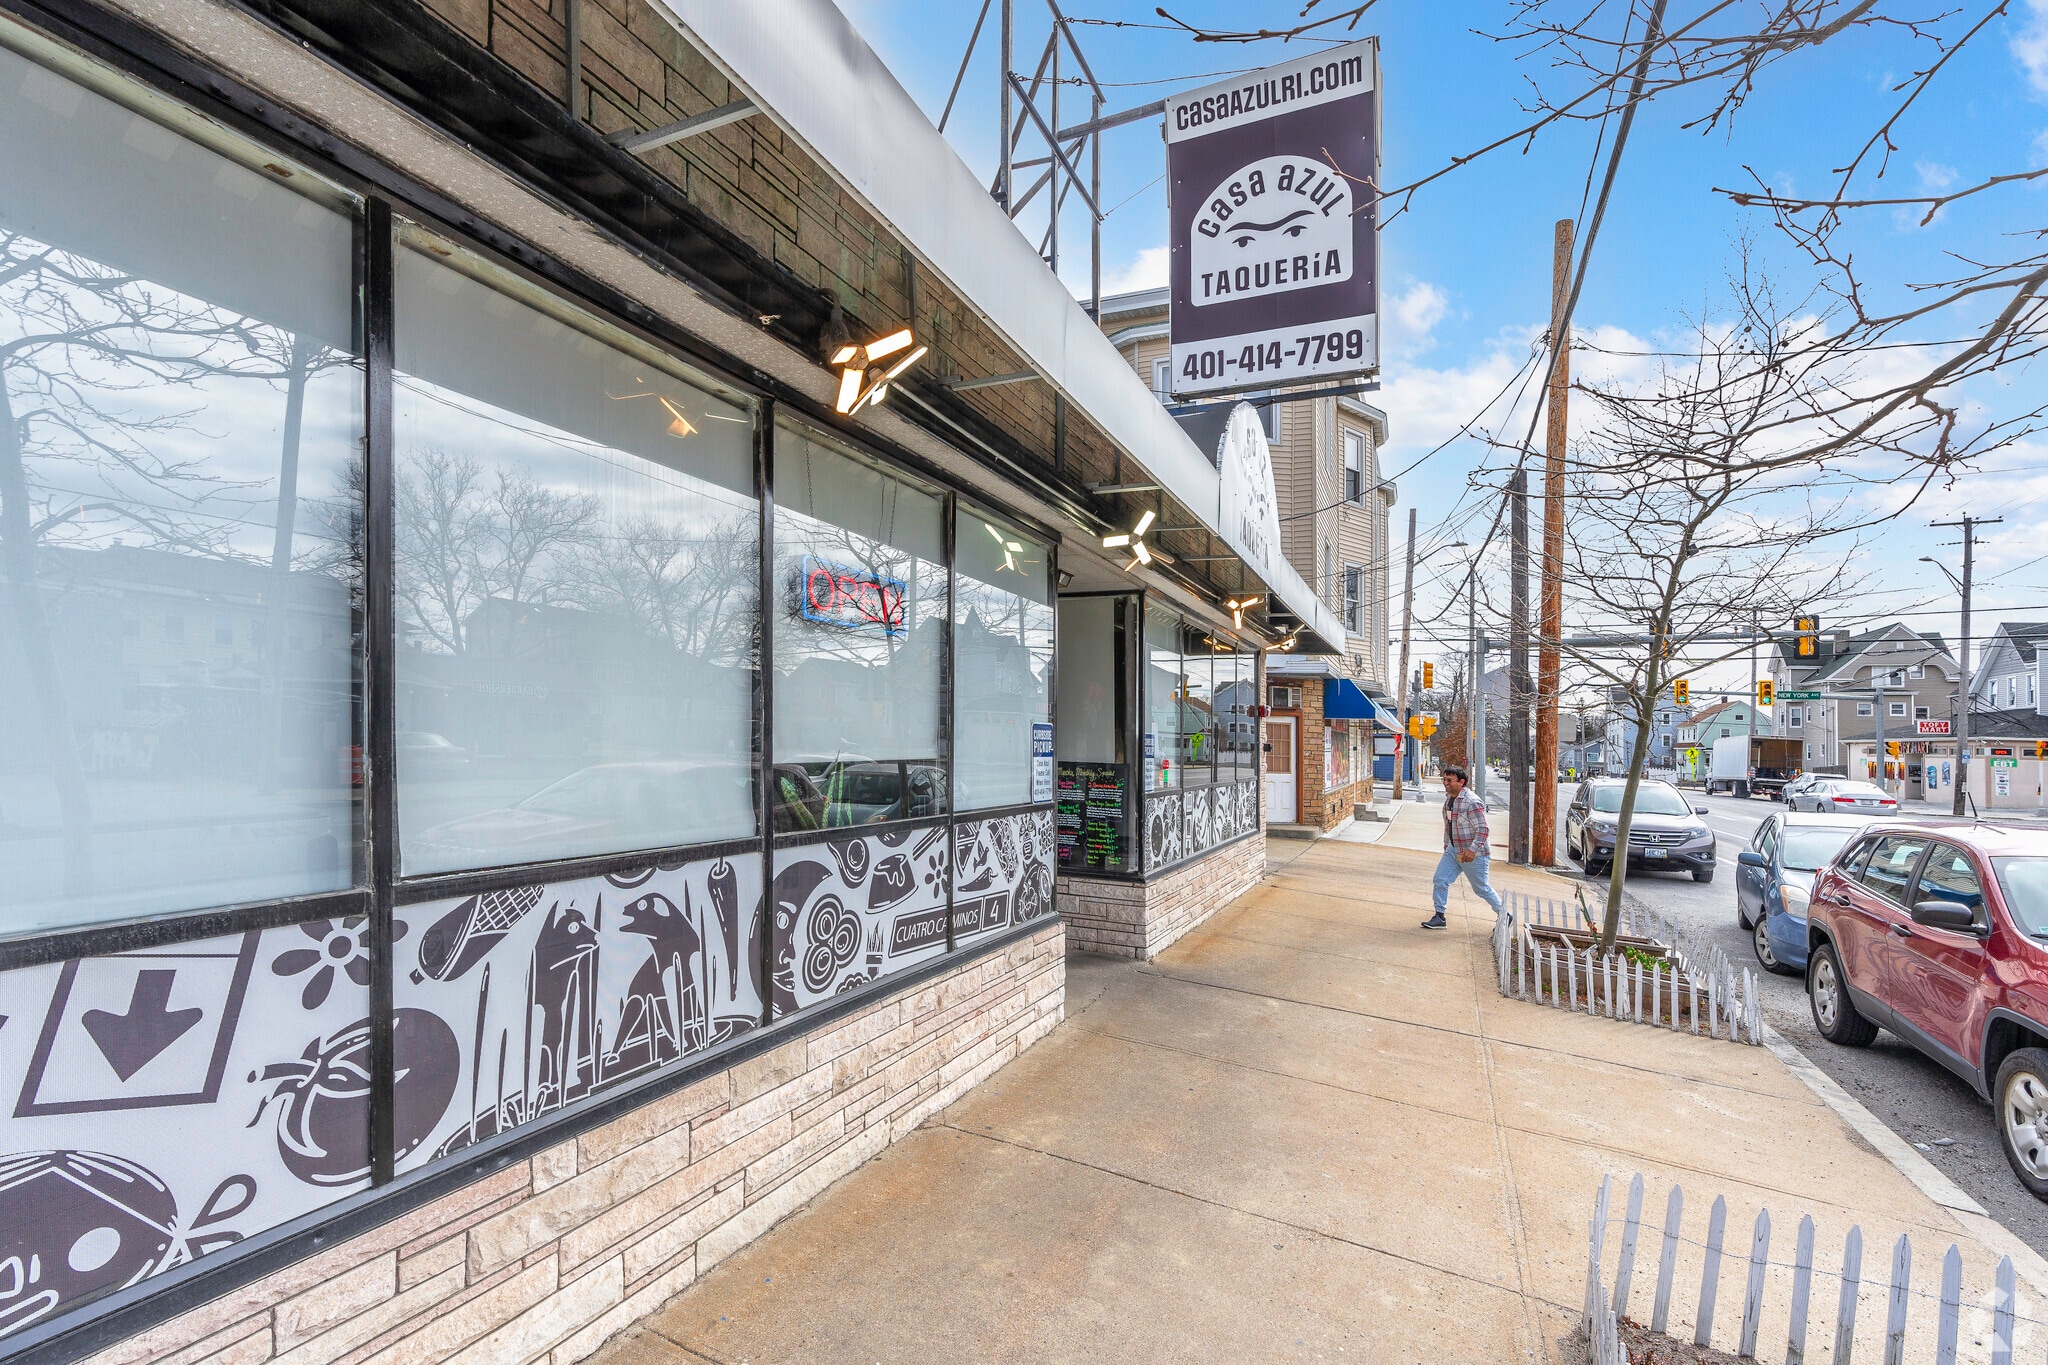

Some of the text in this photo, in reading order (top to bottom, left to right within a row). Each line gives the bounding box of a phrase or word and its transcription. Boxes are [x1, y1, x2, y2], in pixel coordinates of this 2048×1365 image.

[1183, 330, 1363, 381] 401-414-7799
[808, 569, 902, 626] OPEN
[1034, 729, 1052, 740] CURBSIDE
[1034, 741, 1052, 753] PICKUP
[896, 900, 999, 943] CUATRO CAMINOS 4
